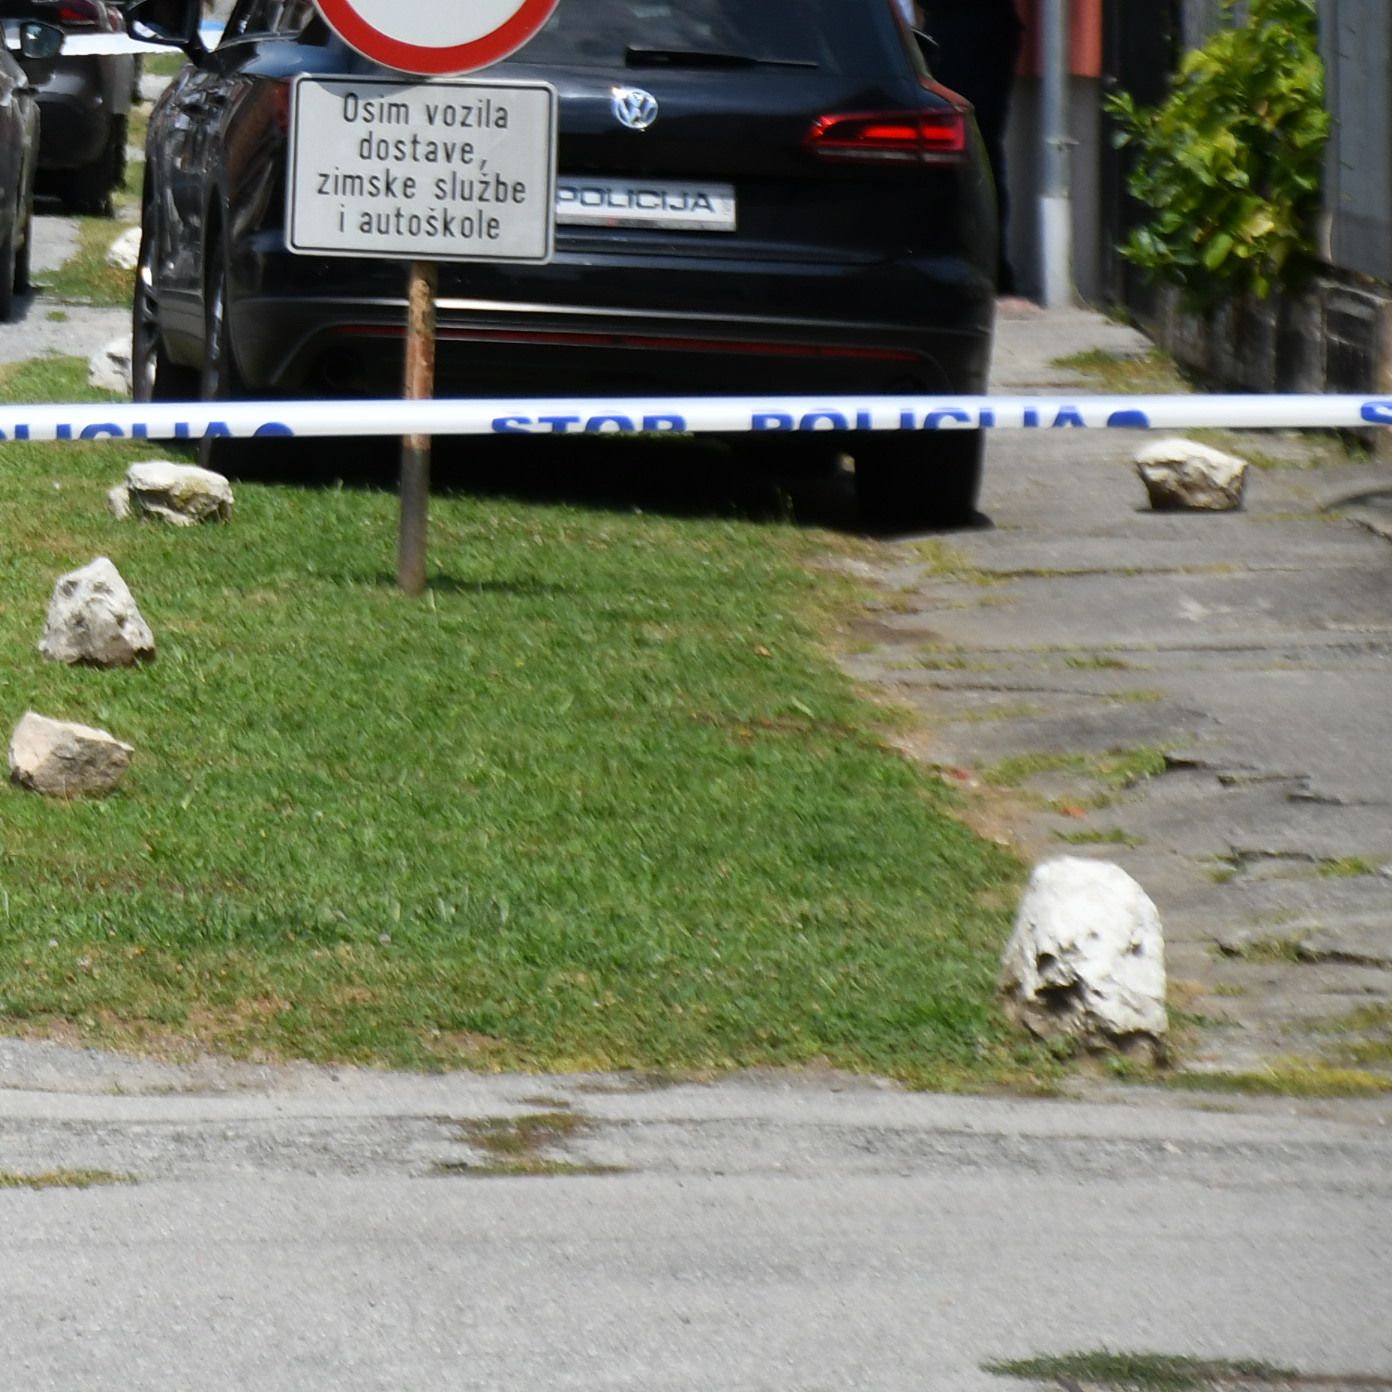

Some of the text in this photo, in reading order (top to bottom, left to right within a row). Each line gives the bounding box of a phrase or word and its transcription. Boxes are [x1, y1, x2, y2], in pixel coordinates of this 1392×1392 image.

[342, 92, 509, 129] Osim vozila
[358, 131, 489, 170] dostave,
[316, 166, 527, 205] zimske službe
[556, 185, 715, 213] POLICIJA
[338, 205, 501, 240] i autoškole
